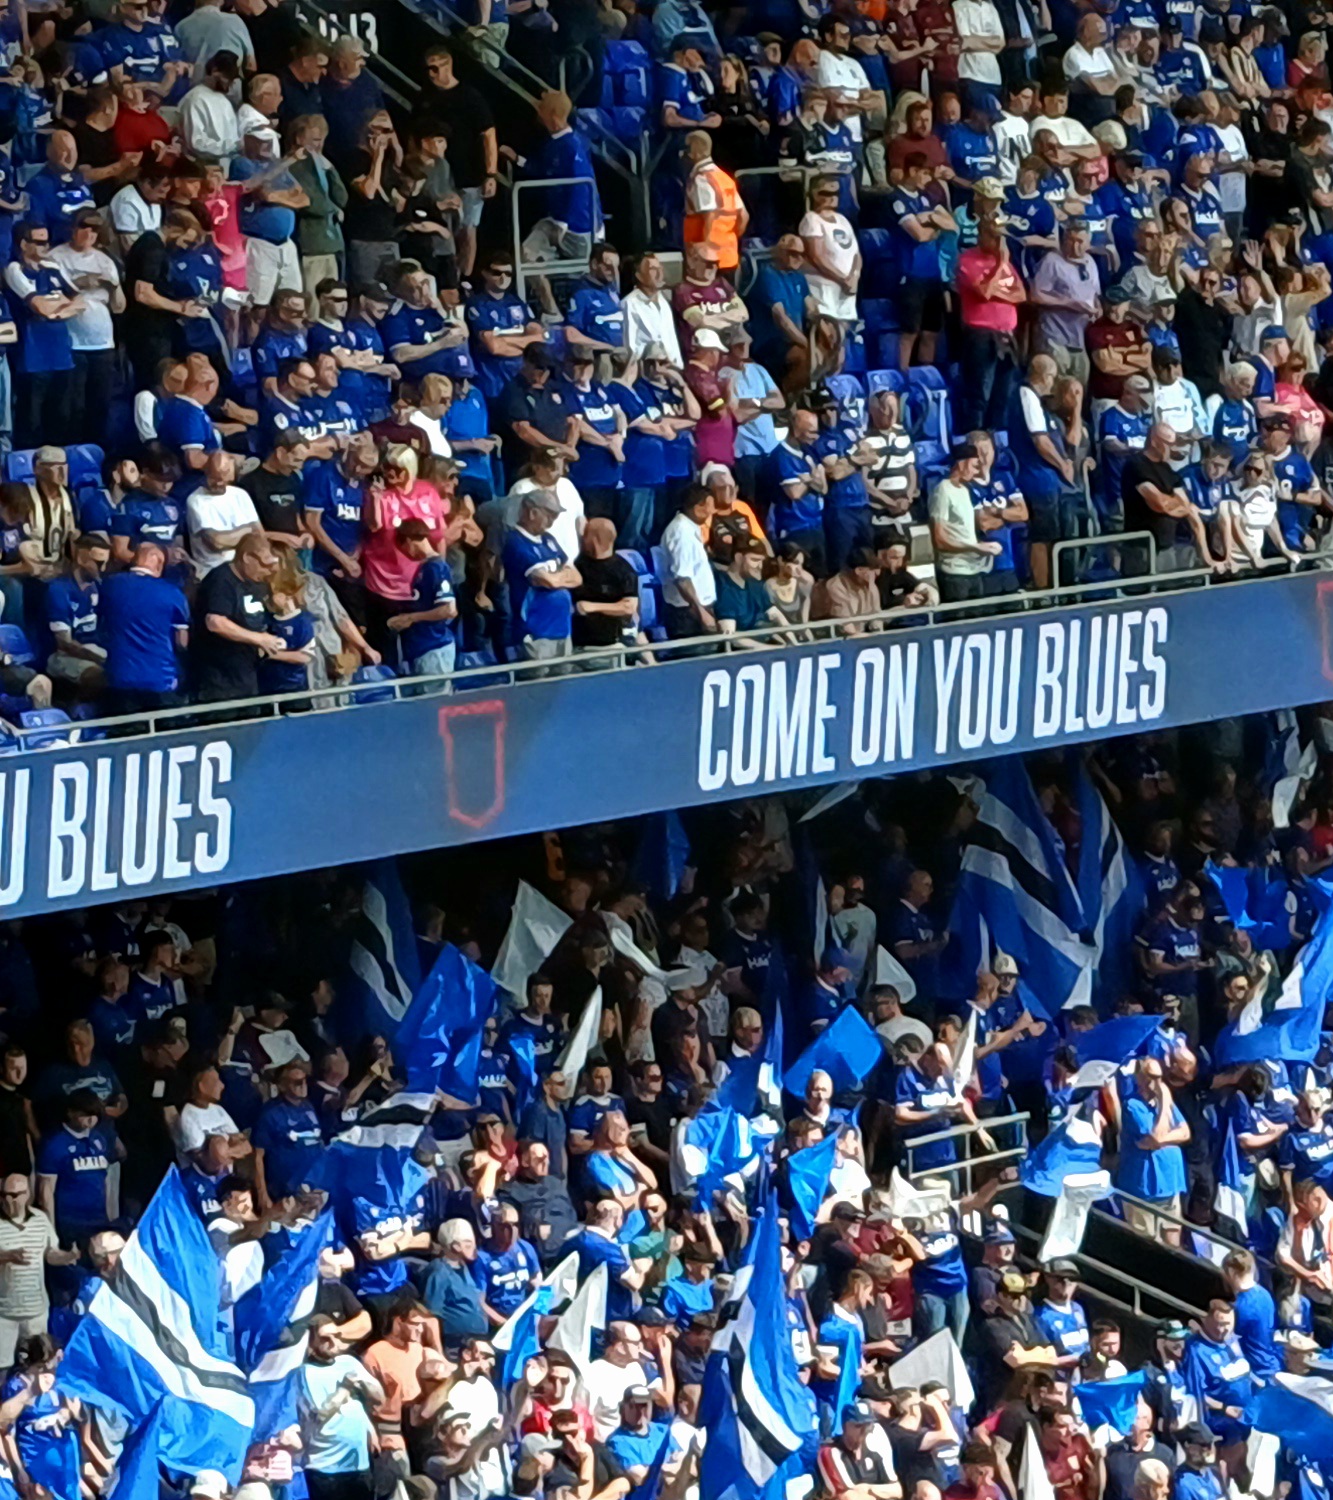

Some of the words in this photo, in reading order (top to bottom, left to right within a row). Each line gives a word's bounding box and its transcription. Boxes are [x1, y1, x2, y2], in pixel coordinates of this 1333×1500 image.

[698, 653, 841, 791] COME
[851, 642, 918, 767] ON
[933, 628, 1022, 754] YOU
[1032, 607, 1167, 739] BLUES
[48, 741, 232, 898] BLUES
